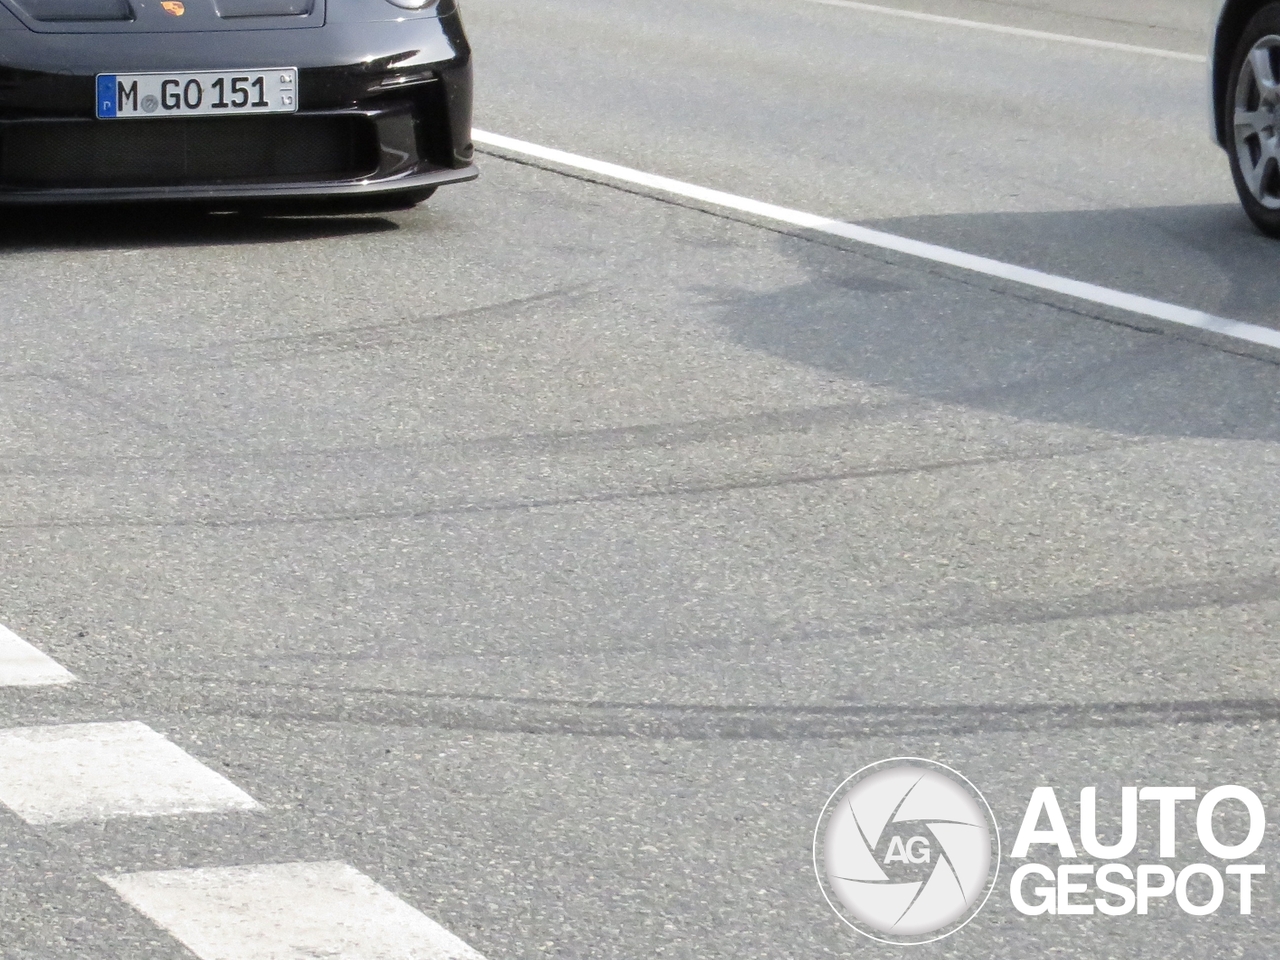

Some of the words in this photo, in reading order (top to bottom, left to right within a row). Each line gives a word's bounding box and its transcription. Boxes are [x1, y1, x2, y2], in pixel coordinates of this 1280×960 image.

[117, 80, 138, 112] M
[161, 78, 203, 111] GO
[211, 76, 269, 109] 151
